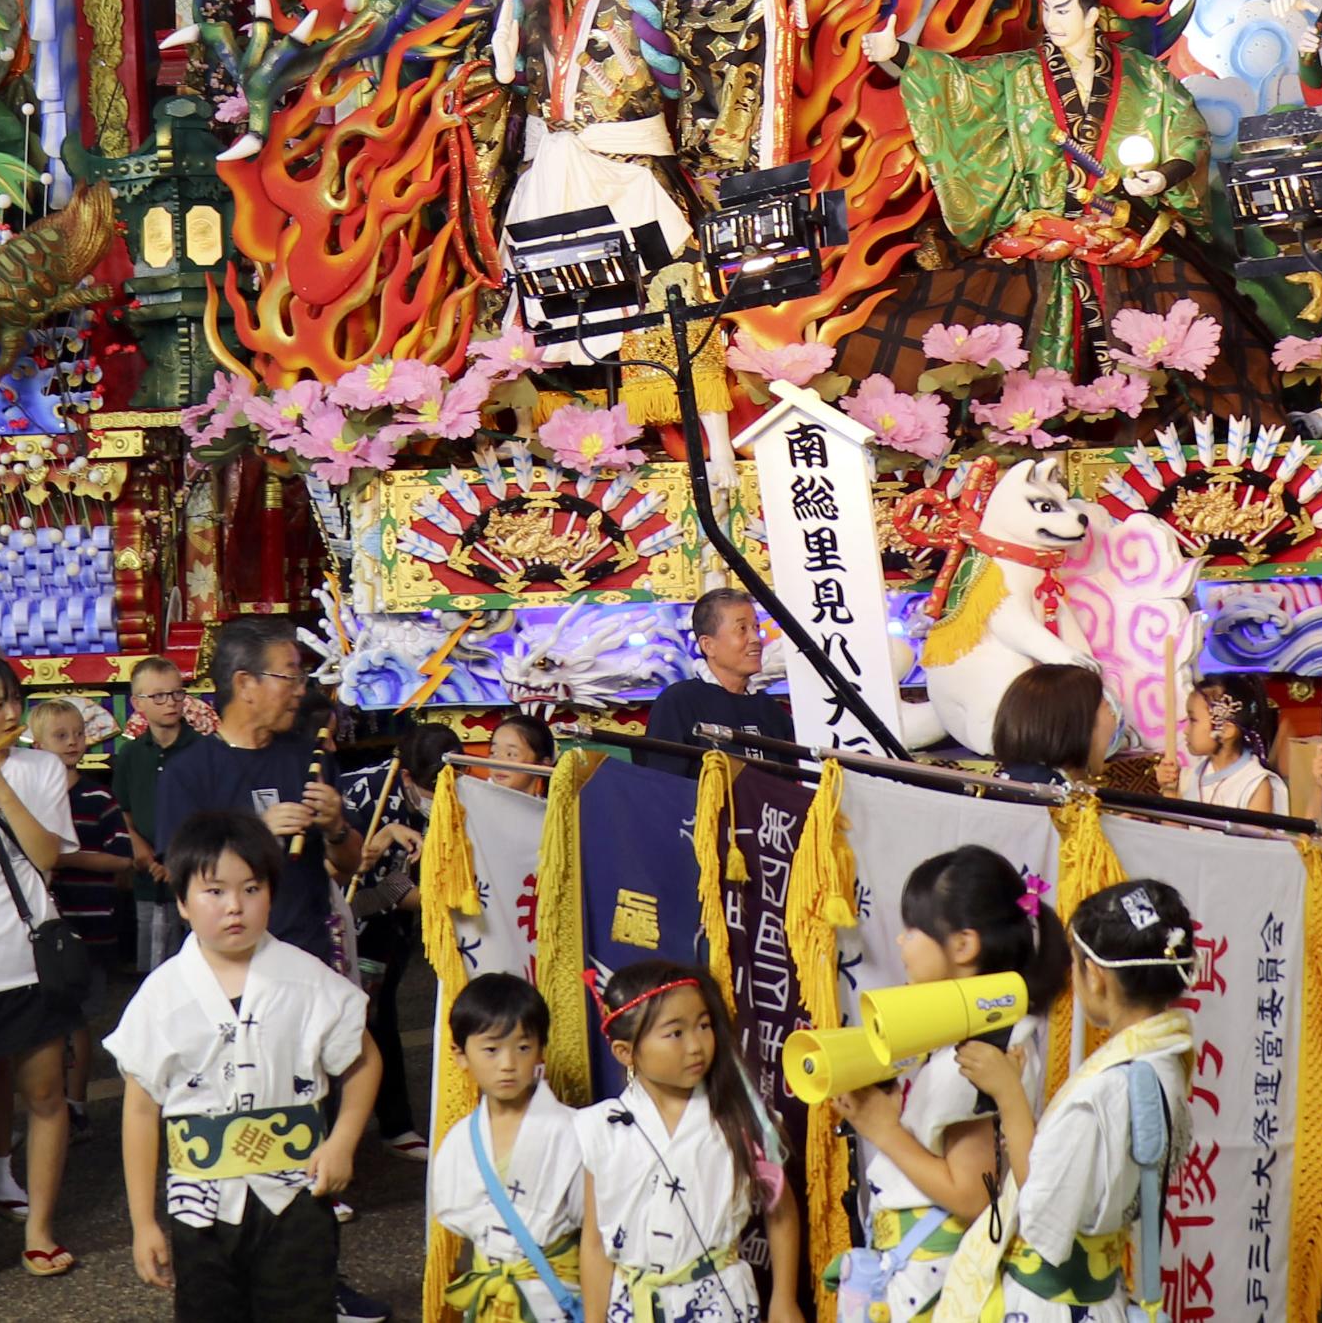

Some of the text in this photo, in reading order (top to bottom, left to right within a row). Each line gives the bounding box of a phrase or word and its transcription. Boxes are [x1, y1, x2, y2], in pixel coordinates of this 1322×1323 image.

[1244, 910, 1286, 1323] 戸三社大祭運営委員会
